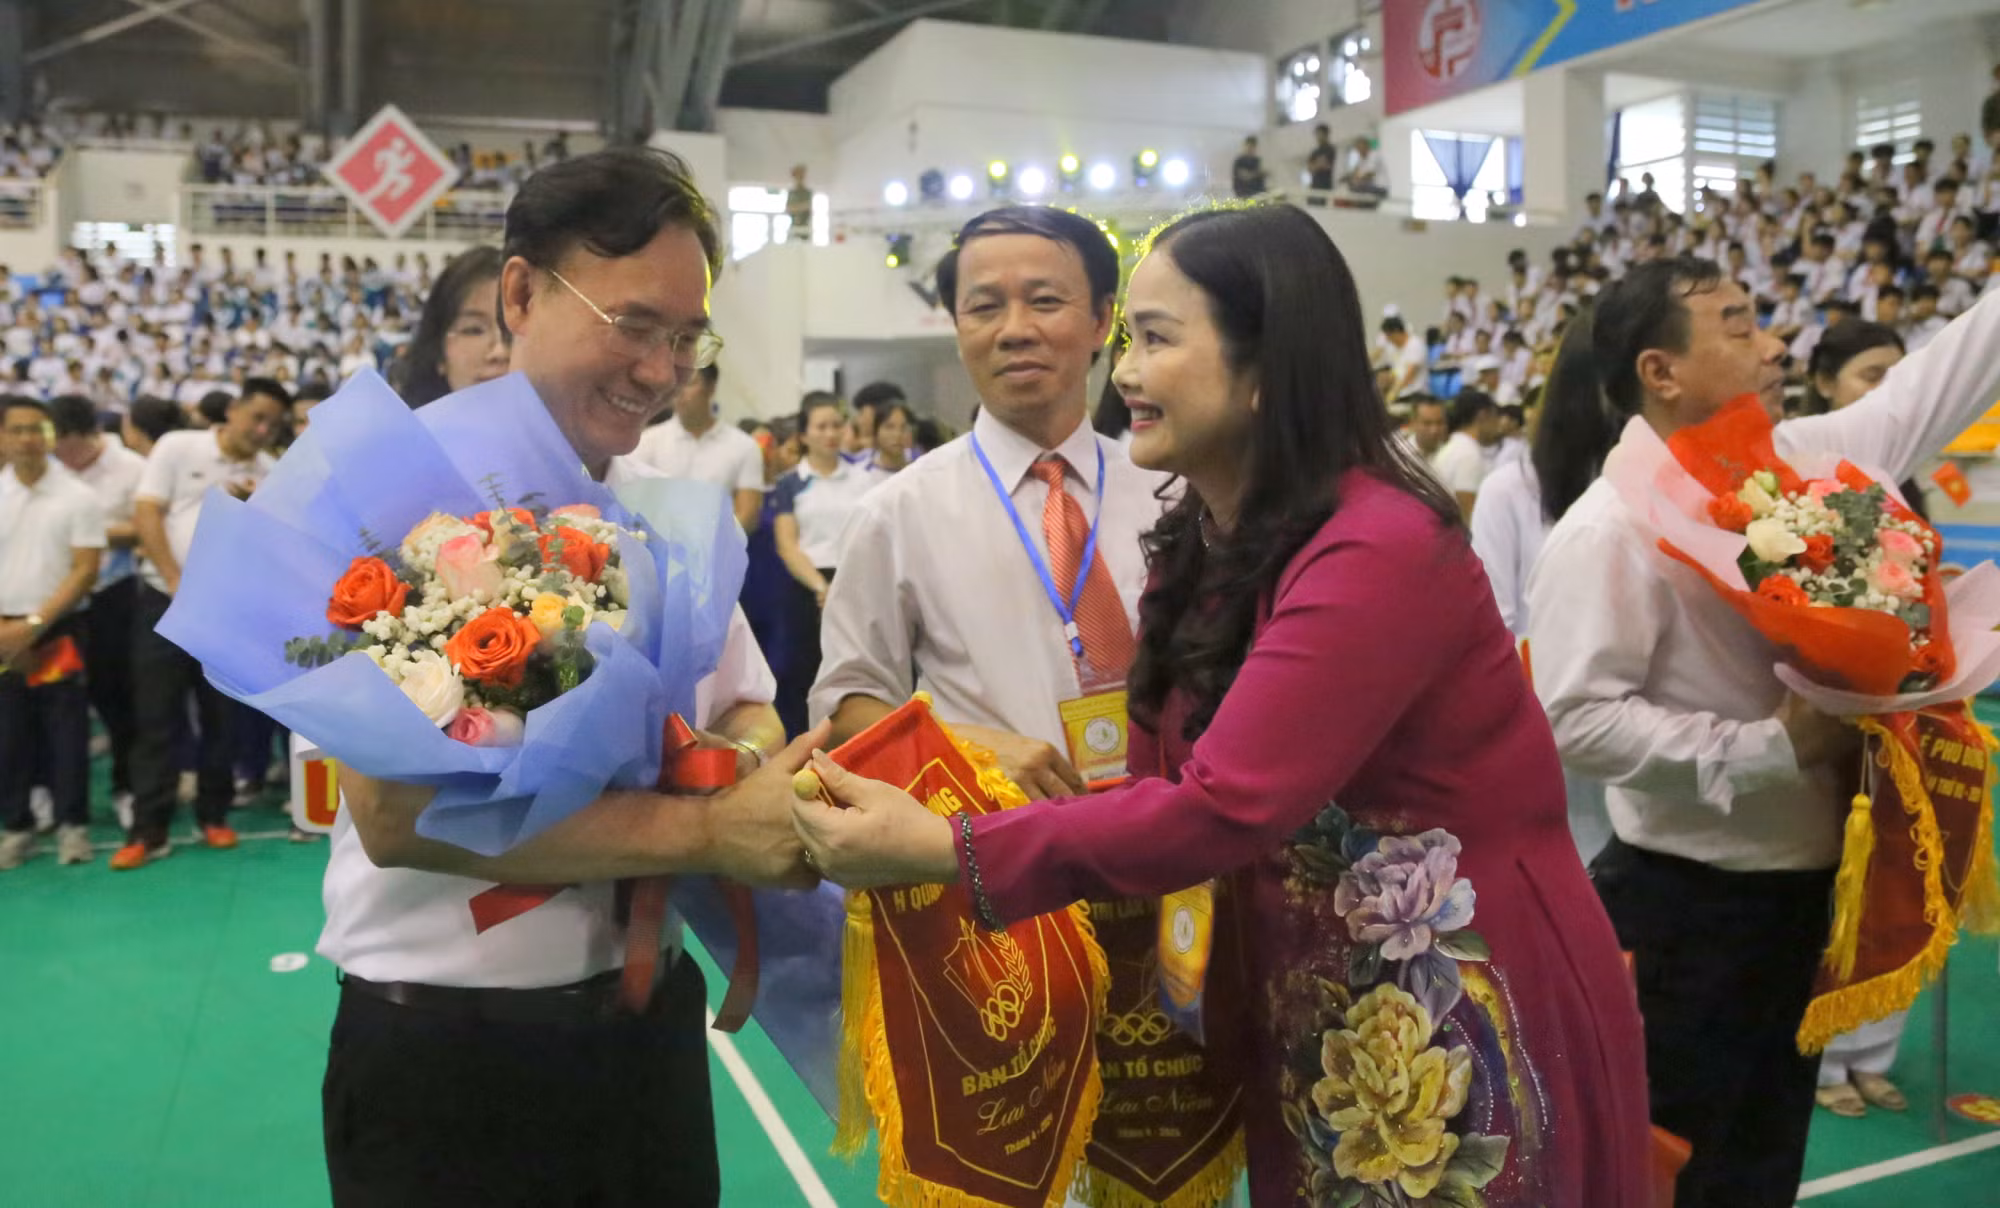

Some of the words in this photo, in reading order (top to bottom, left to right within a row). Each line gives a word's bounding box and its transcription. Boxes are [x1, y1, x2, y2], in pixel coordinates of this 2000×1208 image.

[1101, 1060, 1120, 1078] AN
[1124, 1054, 1148, 1078] TỔ
[961, 1065, 1007, 1096] BAN
